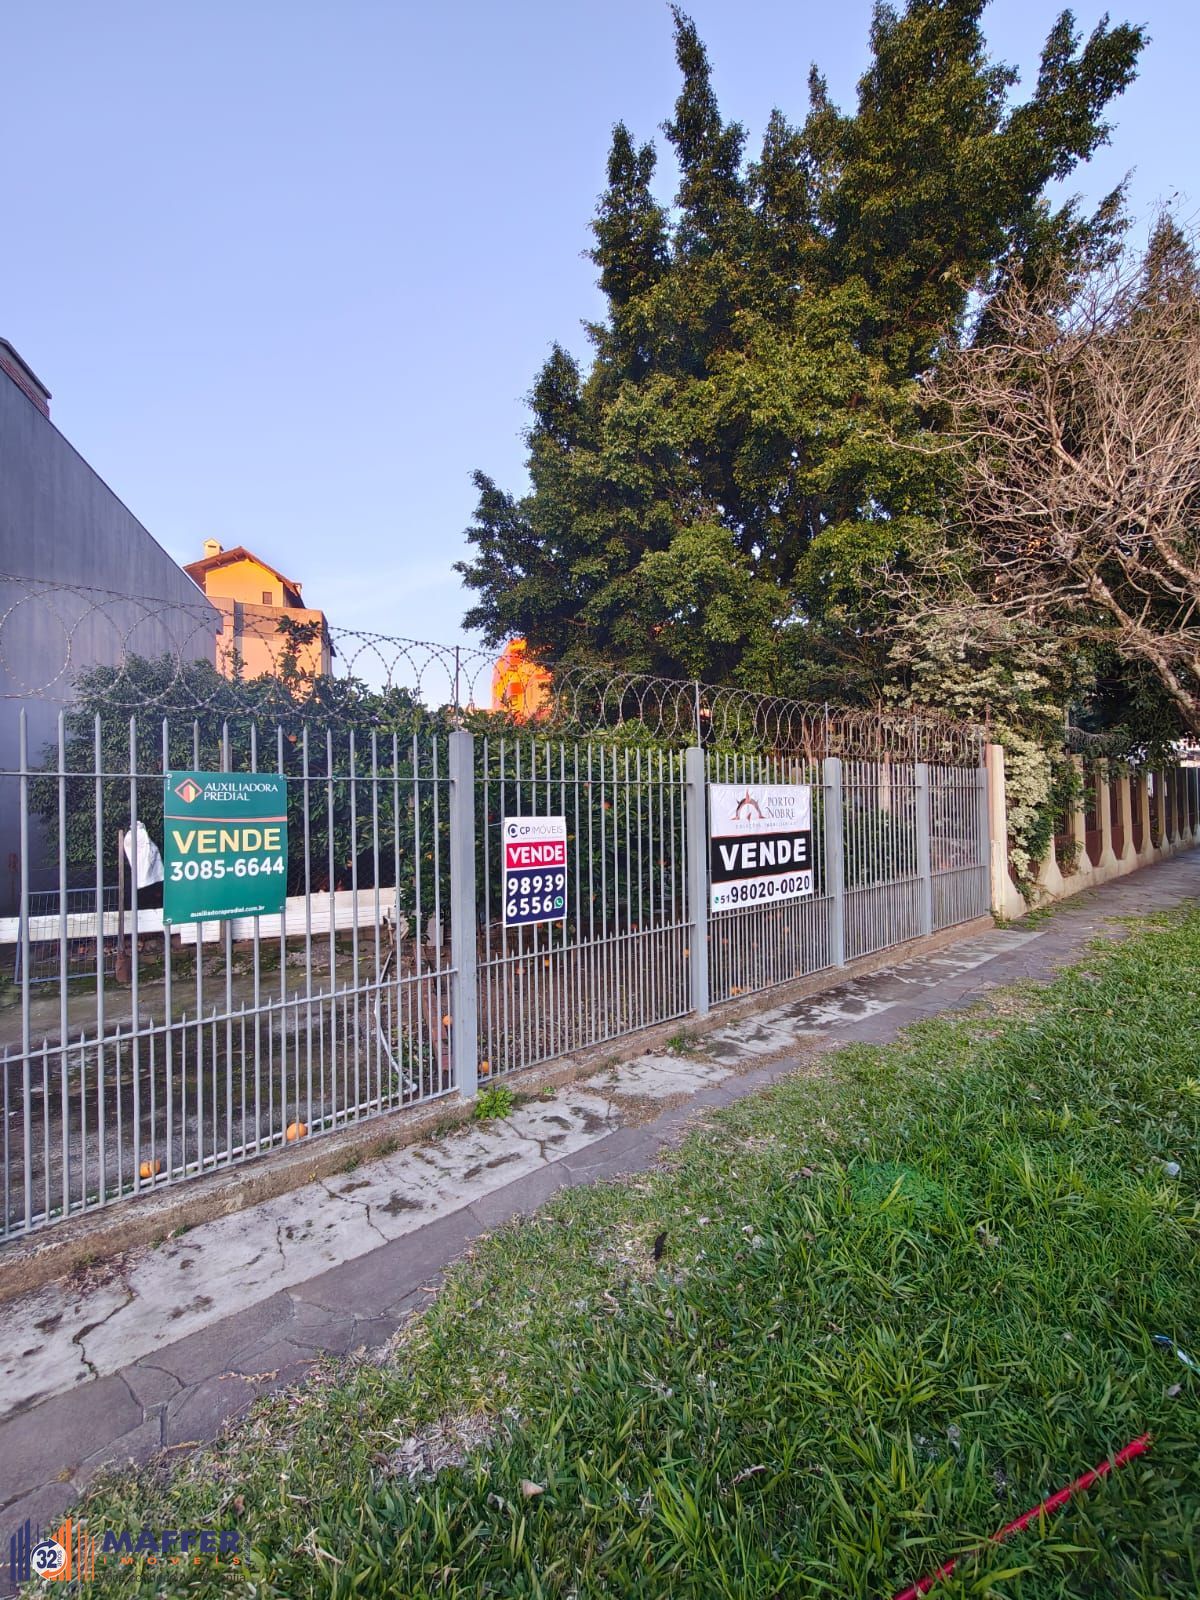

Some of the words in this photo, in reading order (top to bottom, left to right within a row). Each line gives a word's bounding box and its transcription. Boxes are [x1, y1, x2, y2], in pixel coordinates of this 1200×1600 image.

[204, 791, 250, 801] PREDIAL
[205, 783, 279, 793] AUXILIADORA
[768, 796, 795, 807] PORTO
[765, 806, 795, 820] NOBRE
[172, 828, 282, 854] VENDE
[519, 826, 531, 835] CP
[508, 844, 564, 865] VENDE
[719, 838, 806, 871] VENDE
[170, 856, 285, 881] 3085-6644
[508, 873, 565, 896] 98939
[720, 895, 730, 904] 51
[731, 875, 810, 903] 98020-0020
[506, 895, 553, 917] 6556
